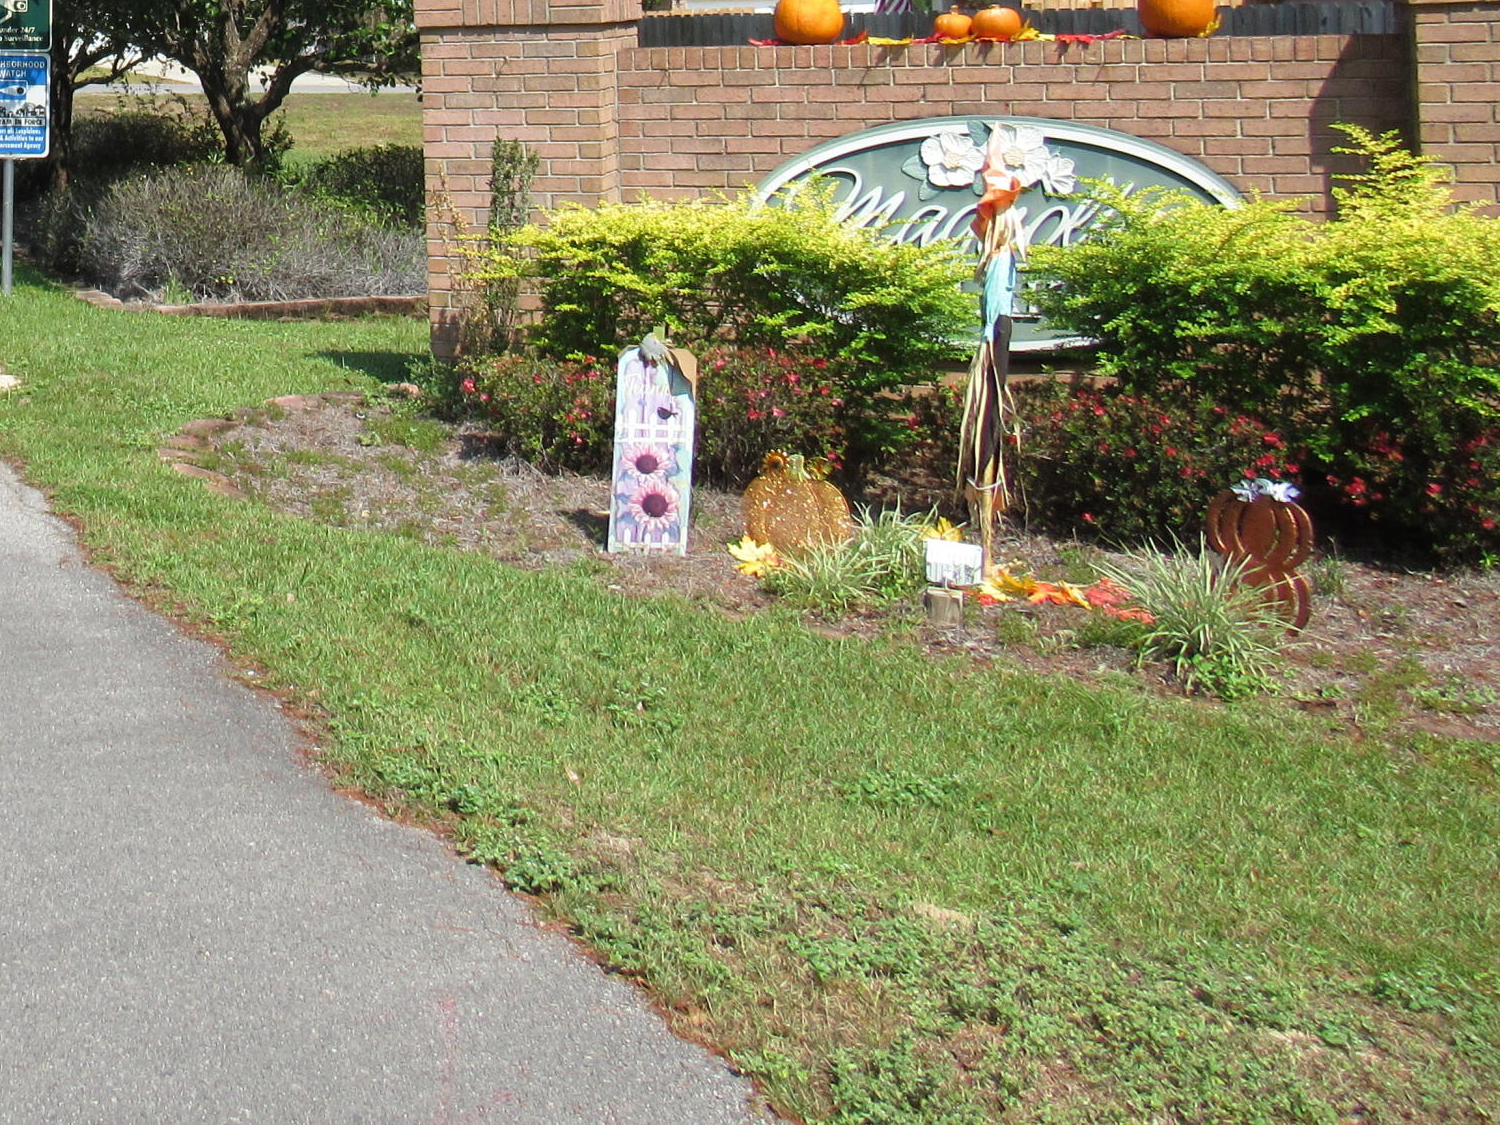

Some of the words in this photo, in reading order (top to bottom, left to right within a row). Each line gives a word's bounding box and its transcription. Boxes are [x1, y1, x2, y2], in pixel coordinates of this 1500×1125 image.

[0, 26, 18, 34] under
[20, 26, 36, 34] 24/7
[4, 34, 43, 42] Surveillance
